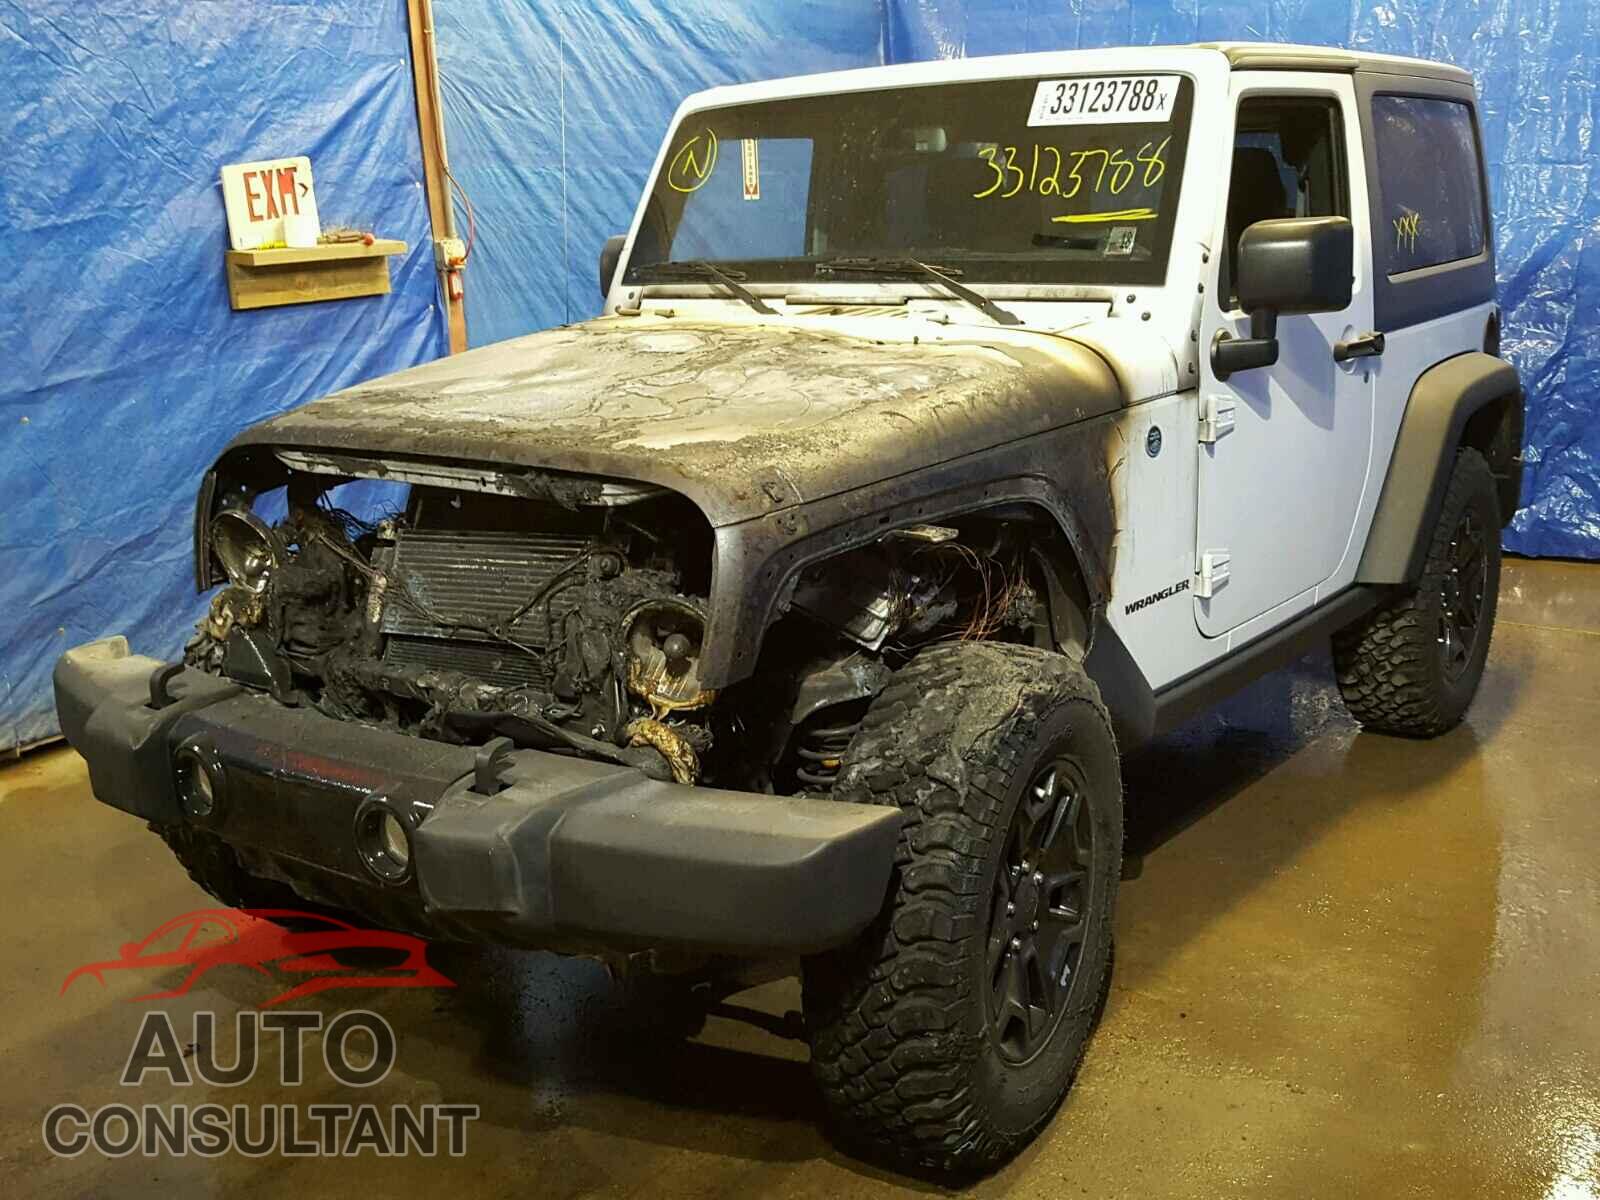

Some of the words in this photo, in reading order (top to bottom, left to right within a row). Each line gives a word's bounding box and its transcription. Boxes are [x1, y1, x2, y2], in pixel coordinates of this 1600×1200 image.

[1050, 79, 1158, 115] 33123788
[973, 135, 1172, 198] 33123788
[243, 166, 299, 222] EXIT
[1124, 579, 1190, 615] WRANGLER
